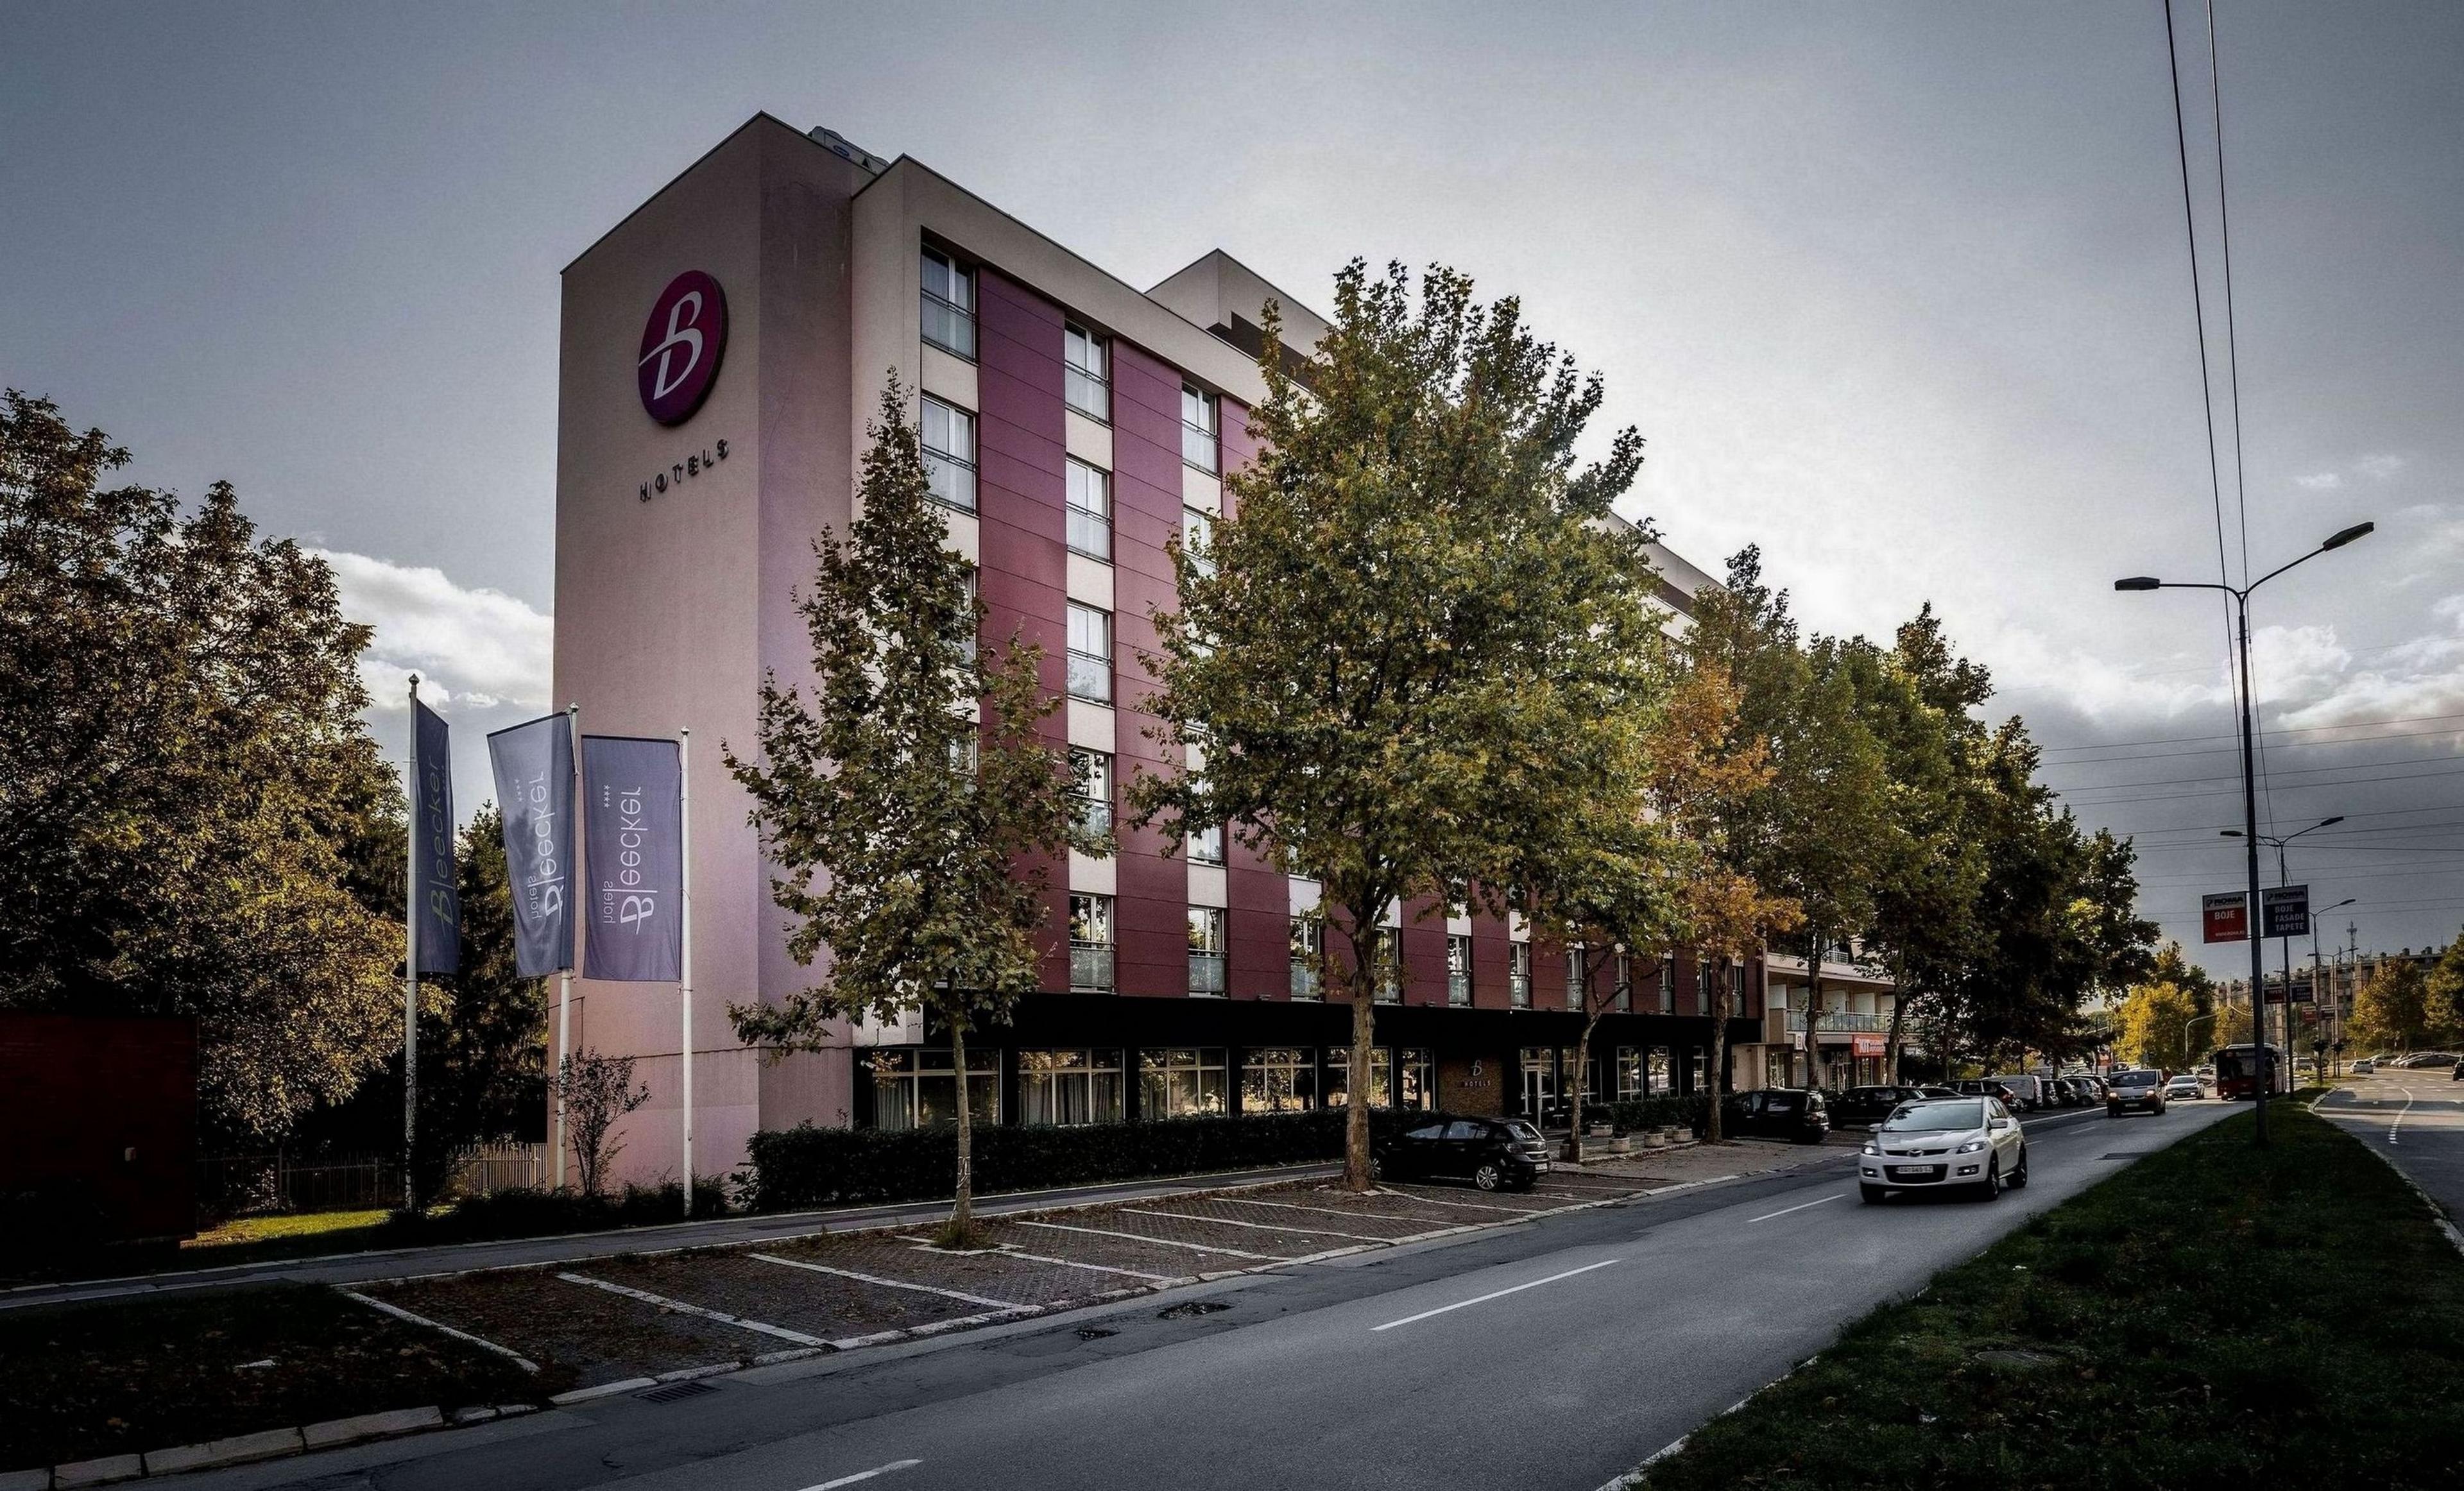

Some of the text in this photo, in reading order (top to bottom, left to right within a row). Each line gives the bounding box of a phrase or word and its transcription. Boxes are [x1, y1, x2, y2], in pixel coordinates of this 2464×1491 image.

[638, 291, 703, 400] B
[639, 438, 730, 502] HOTELS
[427, 755, 454, 938] Bleecker
[2275, 904, 2294, 914] BOJE
[2214, 910, 2235, 920] BOJE
[2275, 913, 2305, 922] FASADE
[2275, 923, 2305, 932] TAPETE
